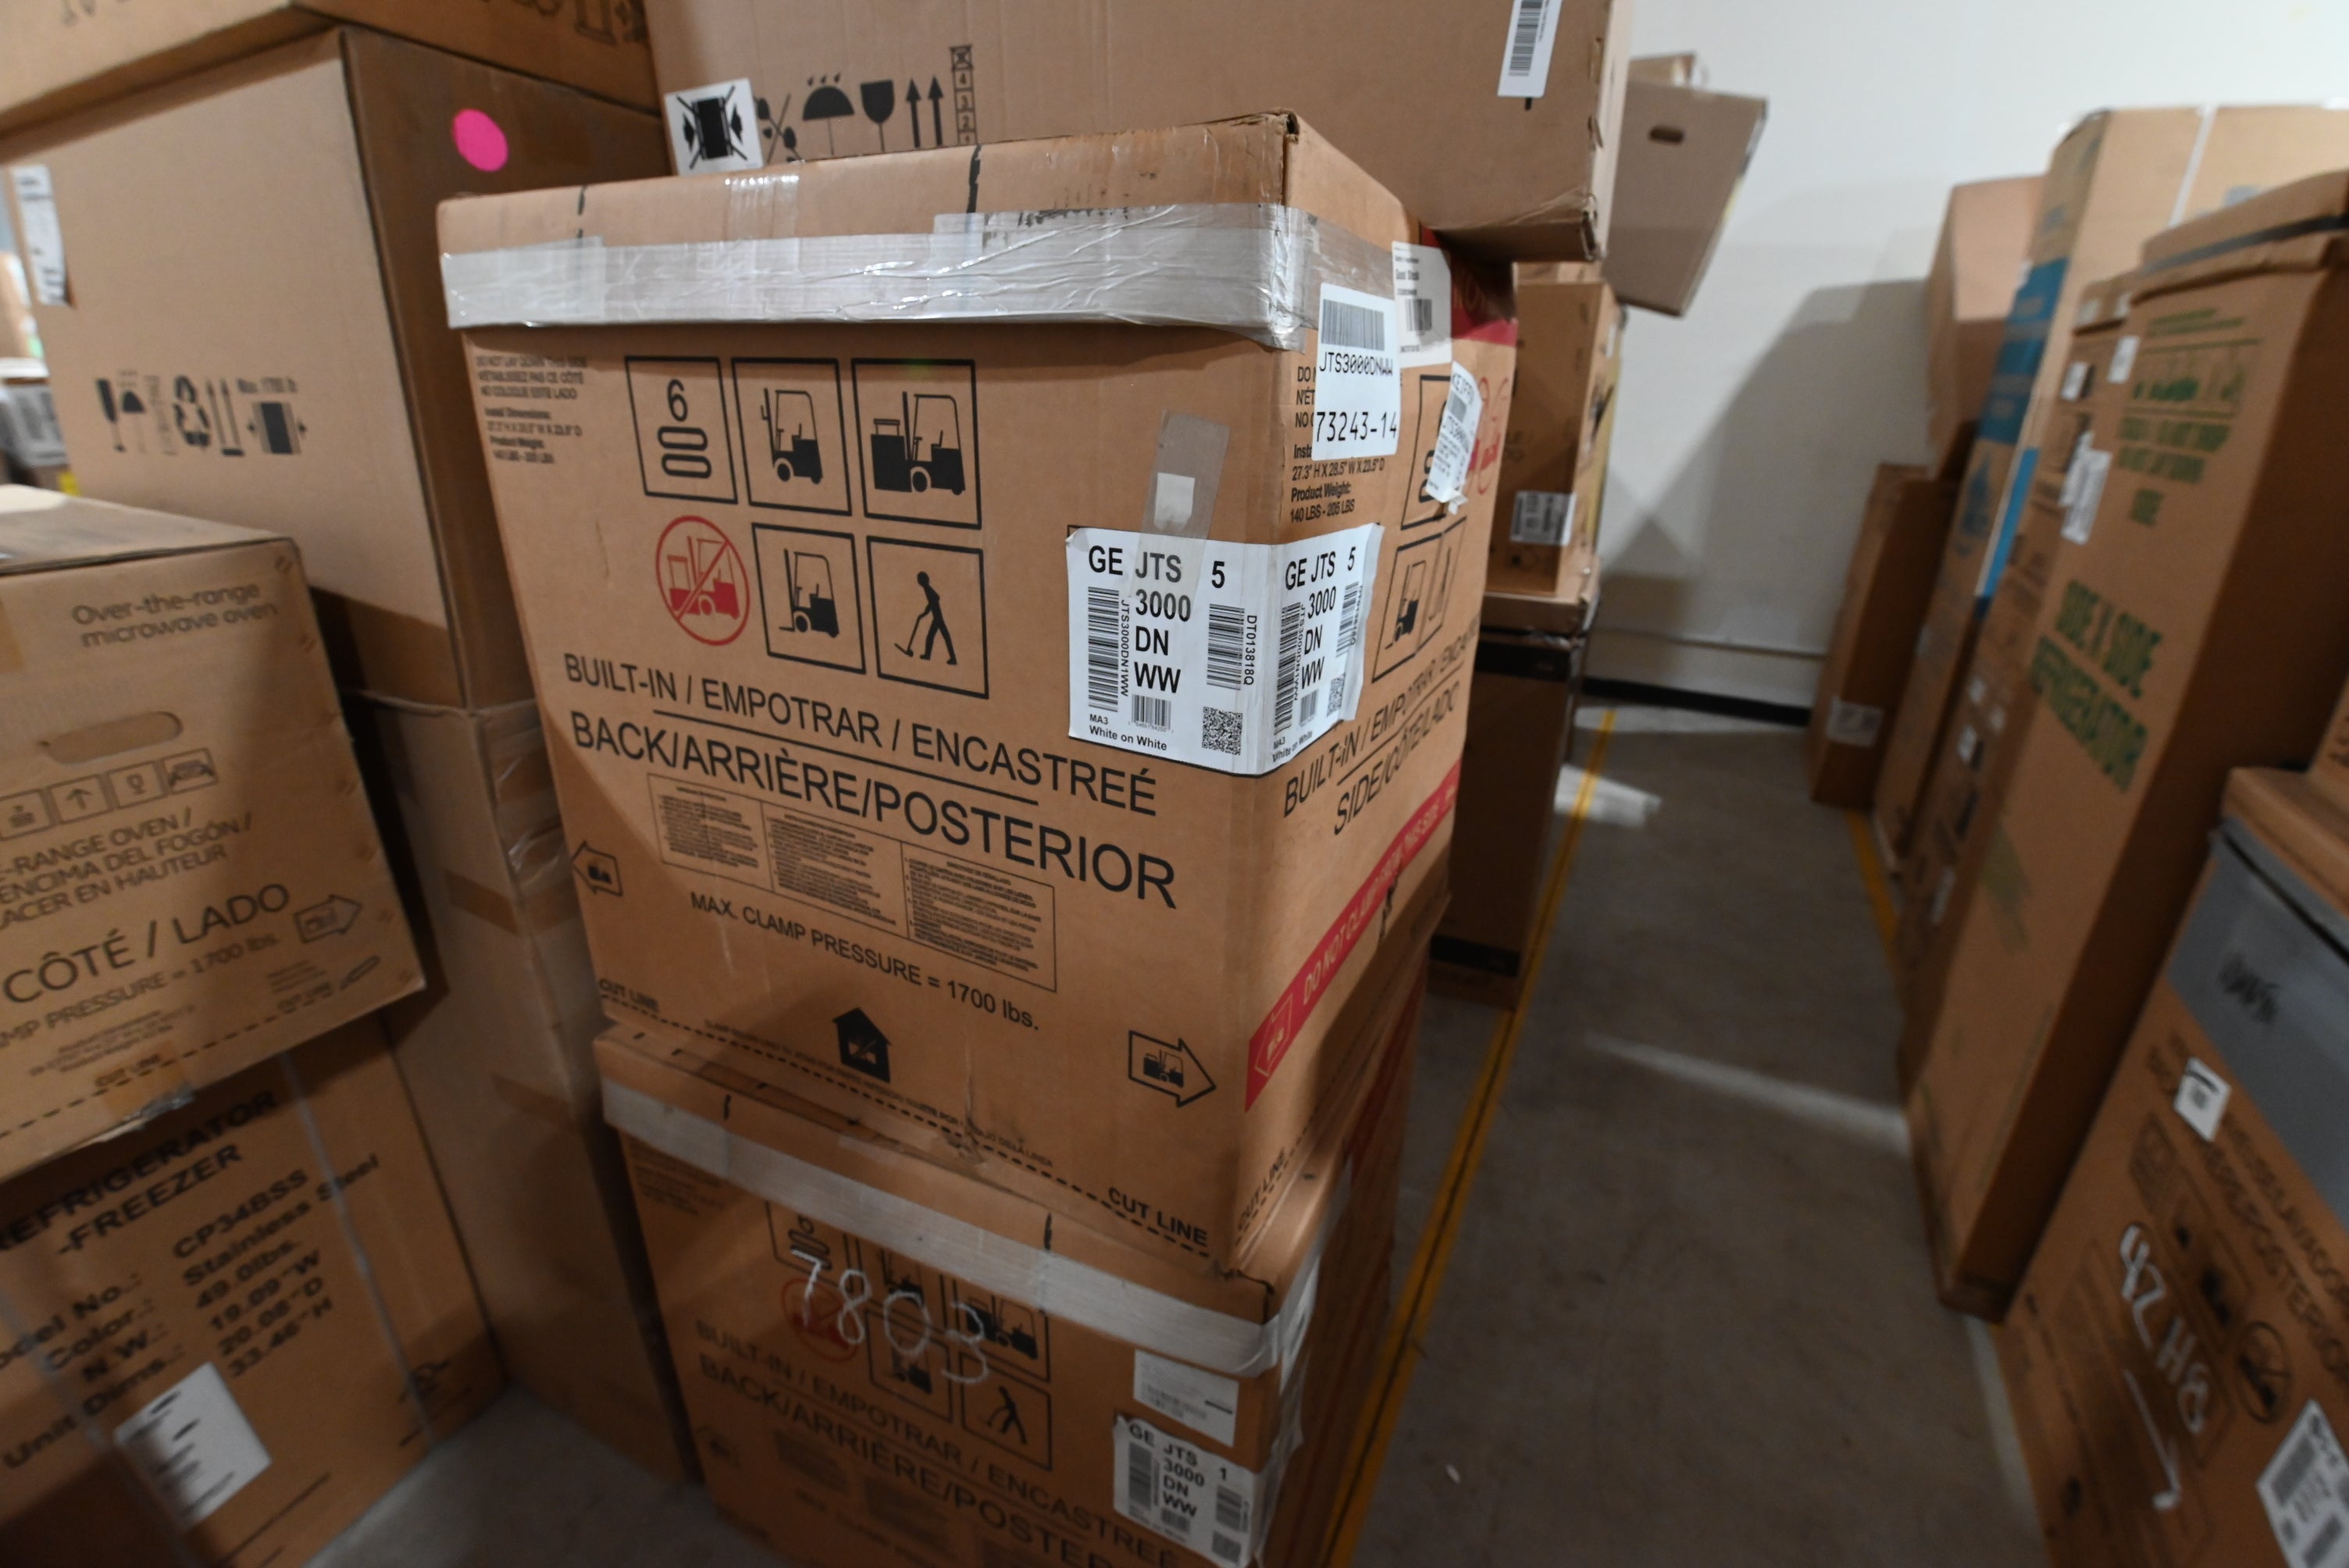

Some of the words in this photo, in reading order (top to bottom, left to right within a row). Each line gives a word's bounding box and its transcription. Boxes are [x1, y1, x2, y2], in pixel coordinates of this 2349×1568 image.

[1297, 366, 1311, 383] DO
[666, 379, 689, 422] 6
[1316, 412, 1397, 443] 73243-14
[1291, 486, 1323, 502] Product
[1089, 545, 1124, 576] GE
[1135, 551, 1182, 583] JTS
[1211, 560, 1225, 589] 5
[1285, 558, 1307, 591] GE
[1310, 551, 1336, 583] JTS
[1347, 547, 1356, 572] 5
[1135, 589, 1191, 622] 3000
[1307, 586, 1337, 619] 3000
[80, 612, 219, 647] microwave
[223, 602, 279, 624] oven
[1135, 625, 1169, 656] DN
[1304, 625, 1323, 656] DN
[1121, 600, 1131, 697] JTS3000DN1WW
[1242, 614, 1258, 686] DT013818Q
[1134, 661, 1182, 693] WW
[1301, 657, 1325, 690] WW
[564, 653, 677, 701] BUILT-IN
[686, 675, 693, 704] /
[702, 677, 882, 748] EMPOTRAR
[892, 718, 901, 752] /
[912, 723, 1157, 817] ENCASTREÉ
[1089, 714, 1109, 725] MA3
[1089, 725, 1117, 740] White
[1121, 733, 1134, 743] on
[1136, 736, 1167, 751] White
[0, 834, 108, 881] -RANGE
[109, 814, 180, 846] OVEN
[103, 846, 155, 872] DEL
[73, 878, 112, 904] EN
[116, 844, 228, 890] HAUTEUR
[2, 928, 136, 1003] CÔTÉ
[147, 920, 158, 958] /
[172, 882, 291, 944] LADO
[690, 891, 739, 920] MAX.
[743, 906, 807, 940] CLAMP
[811, 929, 923, 986] PRESSURE
[947, 979, 997, 1014] 1700
[1002, 999, 1040, 1031] lbs.
[45, 971, 167, 1030] PRESSURE
[1108, 1187, 1150, 1219] CUT
[1157, 1210, 1209, 1248] LINE
[790, 1248, 989, 1384] 7803
[0, 1315, 65, 1367] odel
[813, 1375, 963, 1468] EMPOTRAR
[1129, 1424, 1155, 1447] GE
[1164, 1443, 1198, 1466] JTS
[1219, 1467, 1227, 1481] 1
[1164, 1458, 1205, 1487] 3000
[1162, 1491, 1197, 1516] WW
[1164, 1475, 1189, 1497] DN
